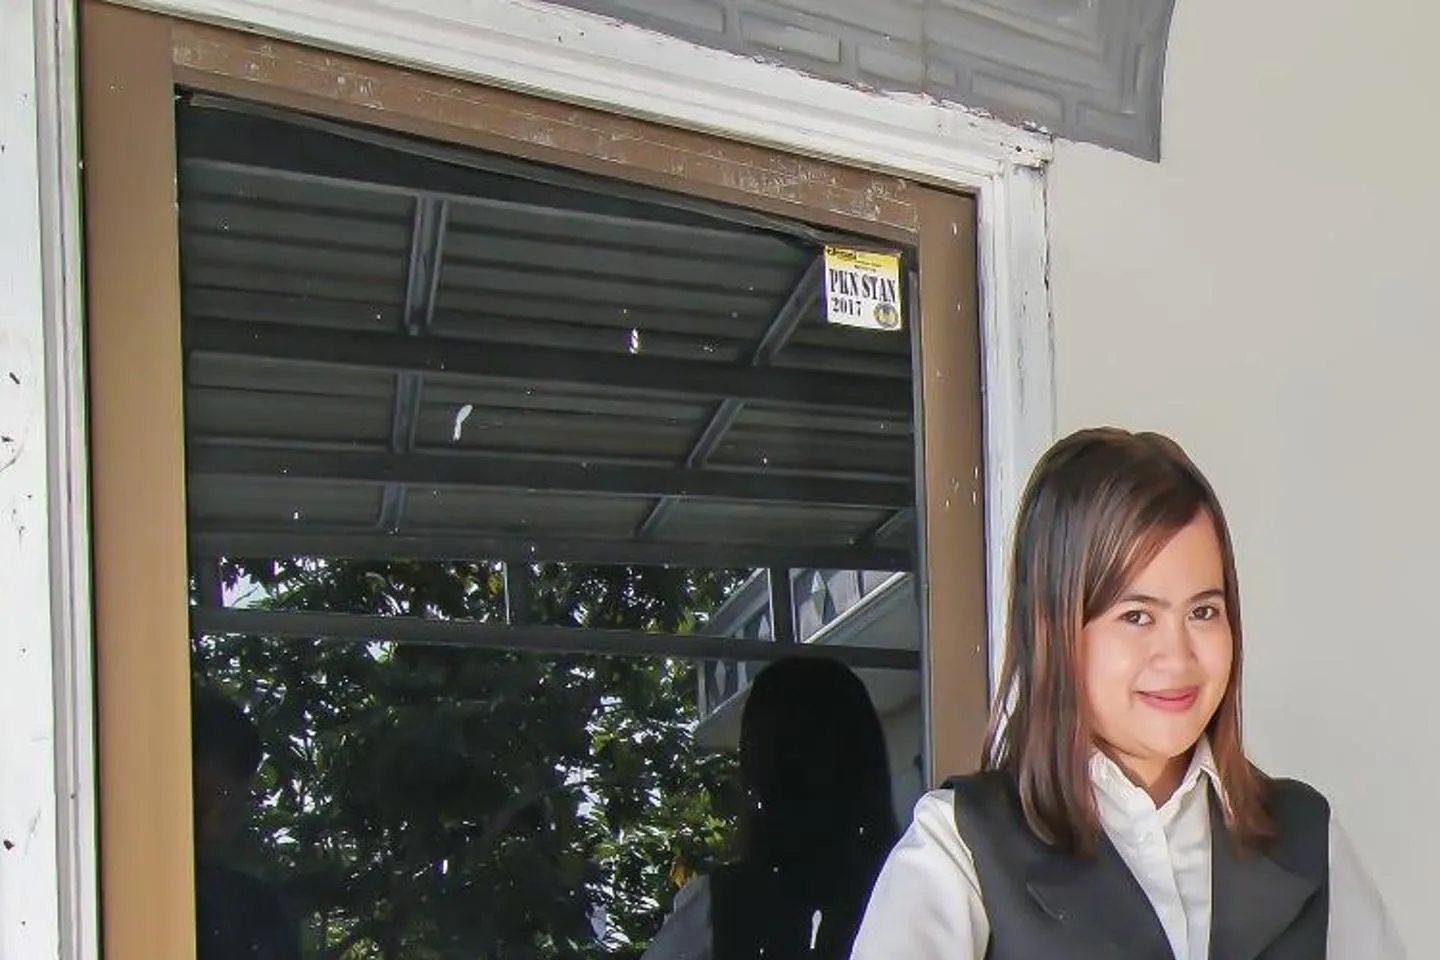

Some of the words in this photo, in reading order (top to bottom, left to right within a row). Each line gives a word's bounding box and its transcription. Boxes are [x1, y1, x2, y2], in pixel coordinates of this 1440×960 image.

[829, 268, 858, 297] PKN
[862, 273, 896, 303] STAN
[831, 297, 861, 316] 2017
